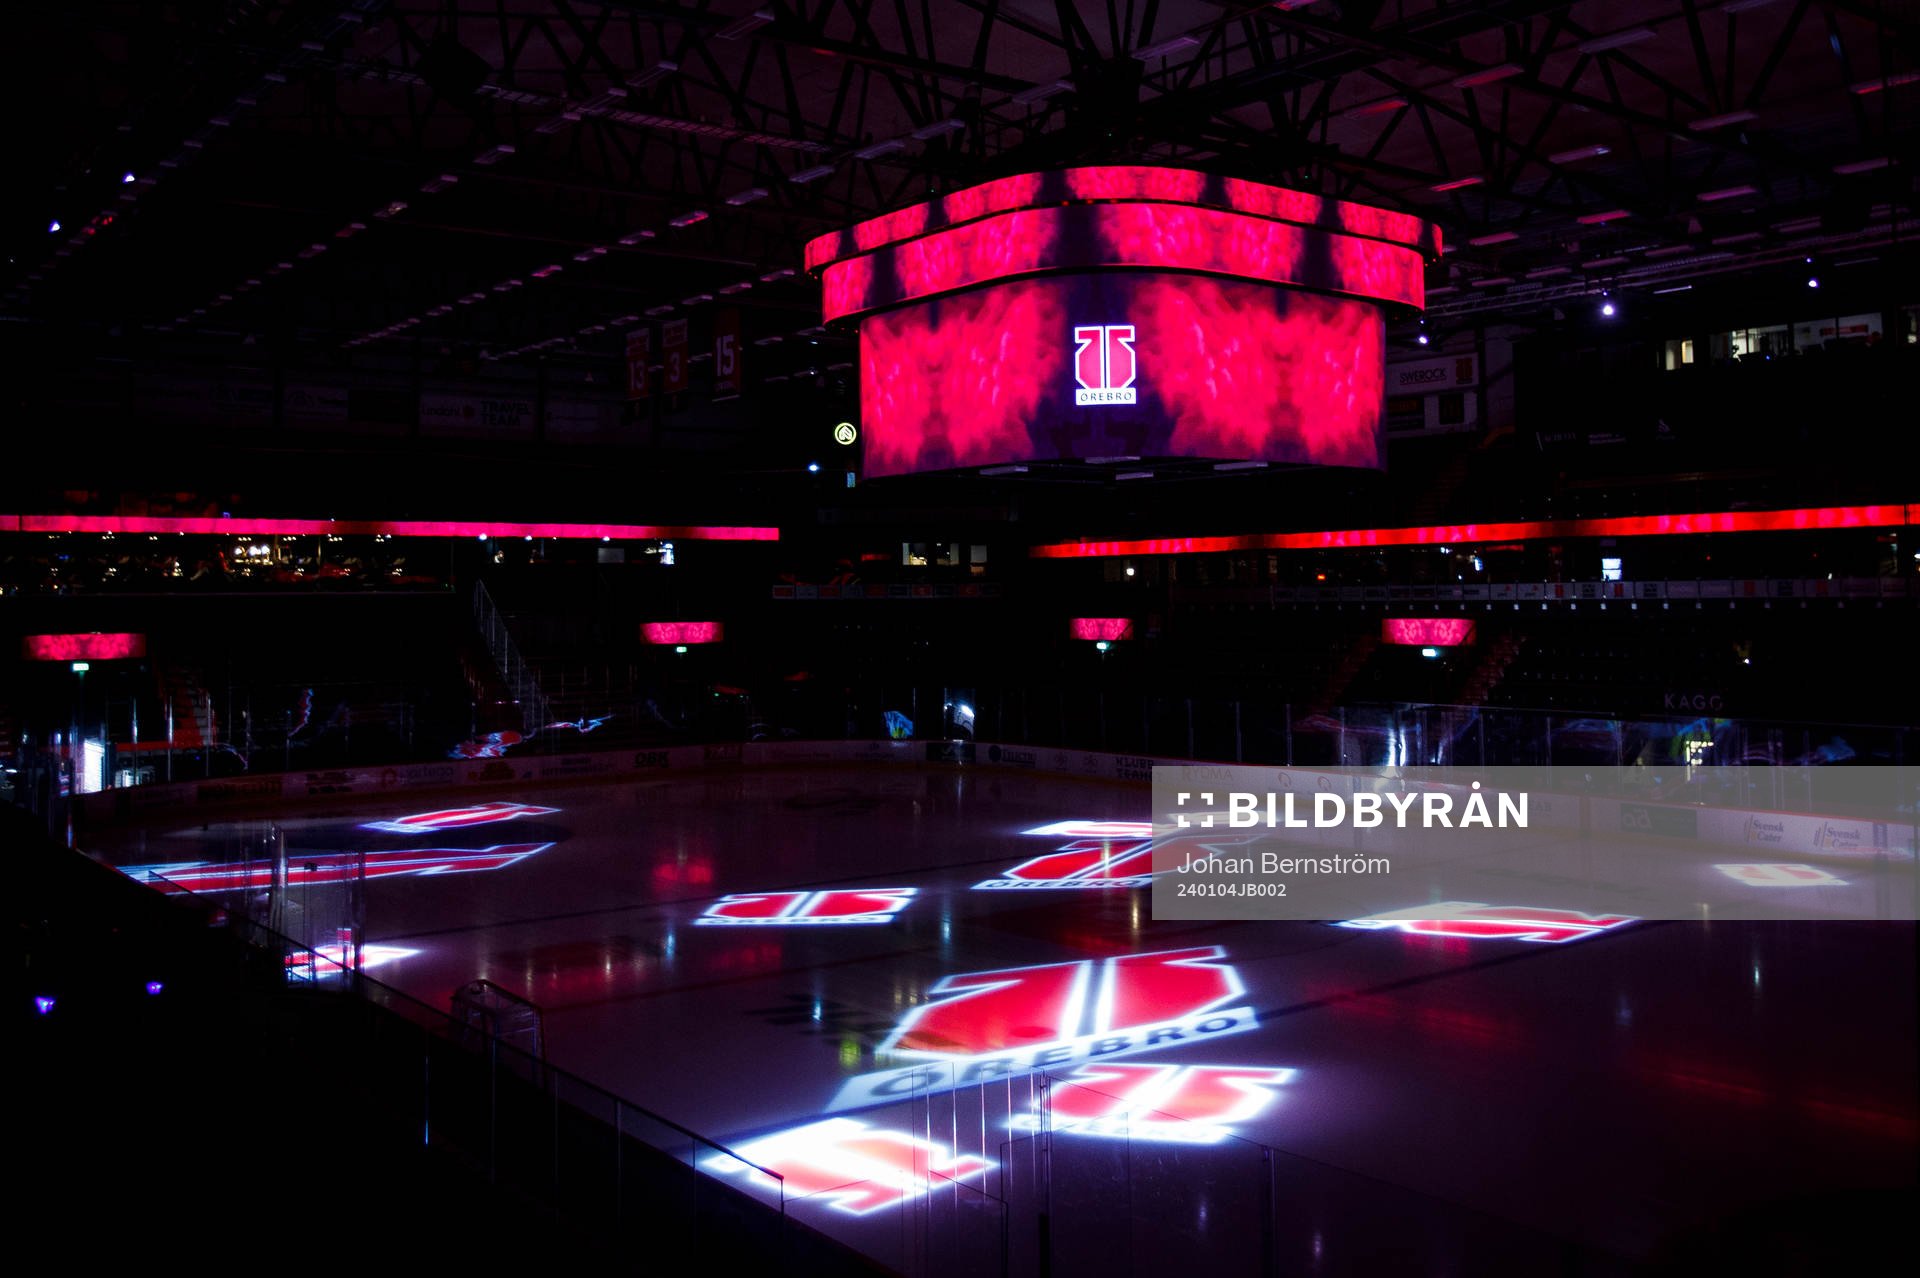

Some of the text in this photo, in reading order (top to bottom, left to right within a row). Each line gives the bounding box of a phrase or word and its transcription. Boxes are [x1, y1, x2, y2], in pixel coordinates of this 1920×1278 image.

[669, 352, 681, 383] 3
[715, 334, 735, 377] 15
[628, 360, 646, 391] 13
[1400, 367, 1447, 384] SWEROCK
